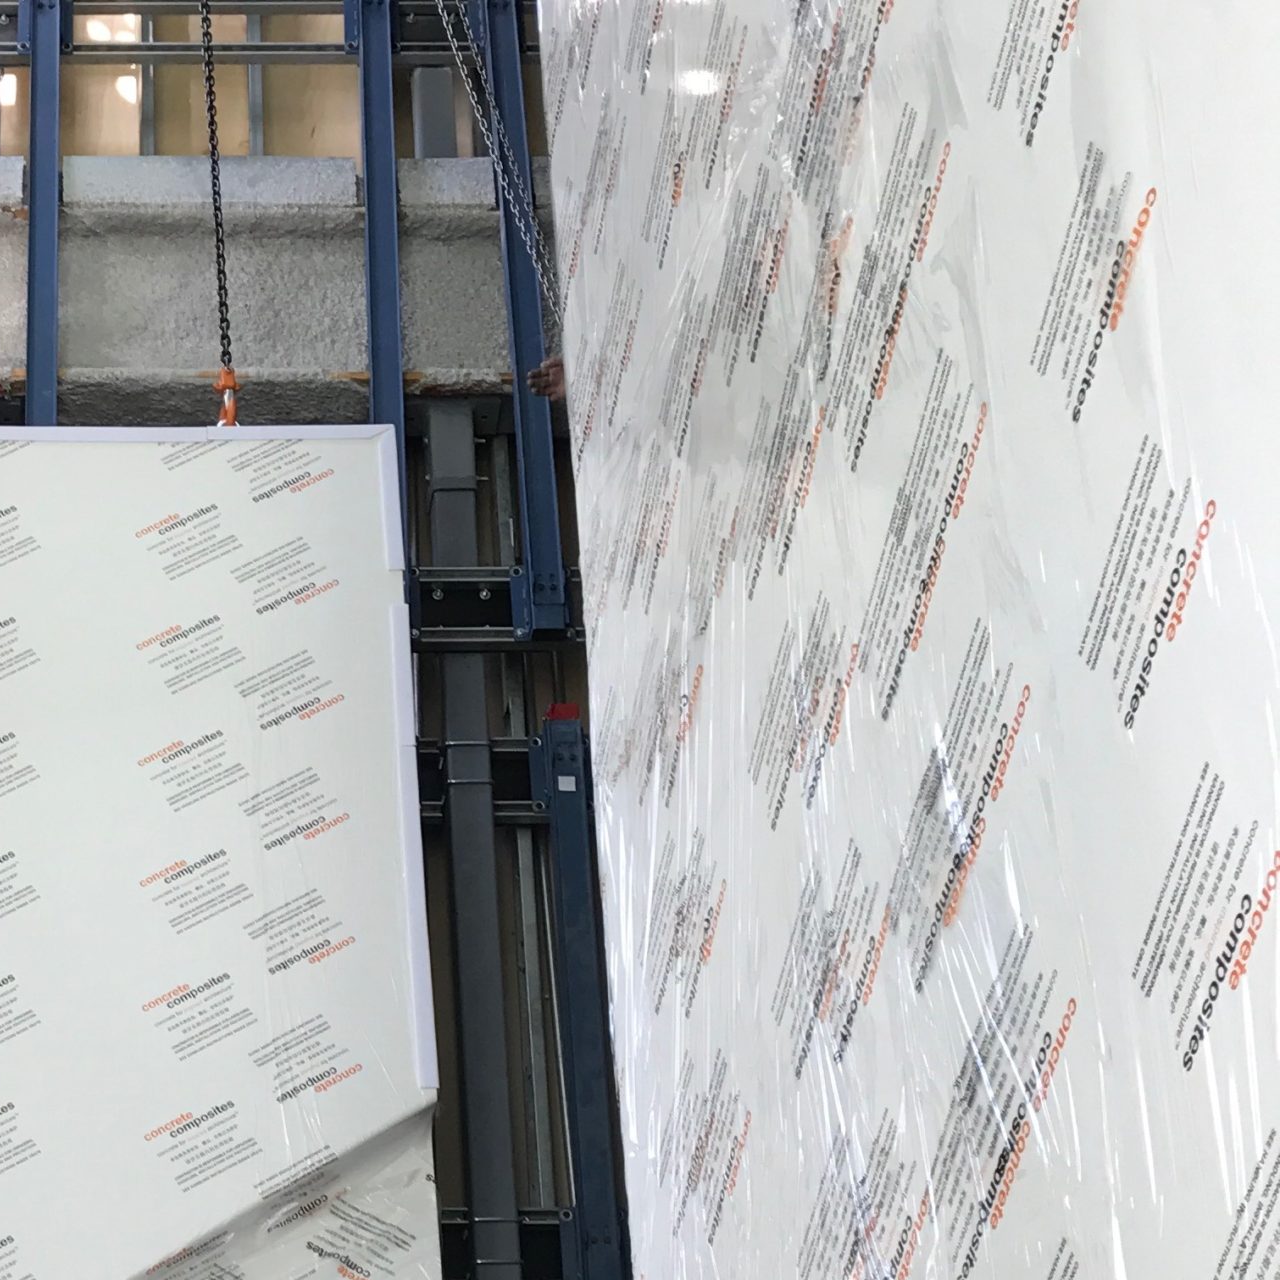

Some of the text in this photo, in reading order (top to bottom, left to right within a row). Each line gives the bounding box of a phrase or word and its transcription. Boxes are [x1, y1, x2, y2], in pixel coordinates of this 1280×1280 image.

[1109, 187, 1157, 331] concrete
[1072, 240, 1125, 423] composites
[952, 401, 988, 519] concrete
[253, 471, 311, 503] composites
[289, 468, 334, 494] concrete
[135, 513, 180, 539] concrete
[158, 504, 218, 536] composites
[1165, 499, 1216, 642] concrete
[256, 582, 316, 615] composites
[294, 579, 339, 605] concrete
[136, 624, 181, 650] concrete
[160, 614, 220, 648] composites
[1124, 548, 1187, 729] composites
[260, 696, 320, 730] composites
[299, 694, 344, 720] concrete
[138, 740, 184, 767] concrete
[161, 730, 224, 764] composites
[991, 685, 1030, 801] concrete
[264, 816, 326, 851] composites
[303, 812, 350, 840] concrete
[164, 849, 227, 884] composites
[1233, 819, 1259, 880] concrete
[140, 859, 187, 887] concrete
[269, 939, 331, 975] composites
[308, 936, 356, 964] concrete
[142, 983, 190, 1013] concrete
[167, 972, 230, 1009] composites
[1183, 894, 1252, 1071] composites
[276, 1066, 337, 1104] composites
[314, 1064, 363, 1093] concrete
[144, 1112, 192, 1141] concrete
[170, 1100, 234, 1138] composites
[990, 1120, 1030, 1230] concrete
[306, 1240, 370, 1278] composites
